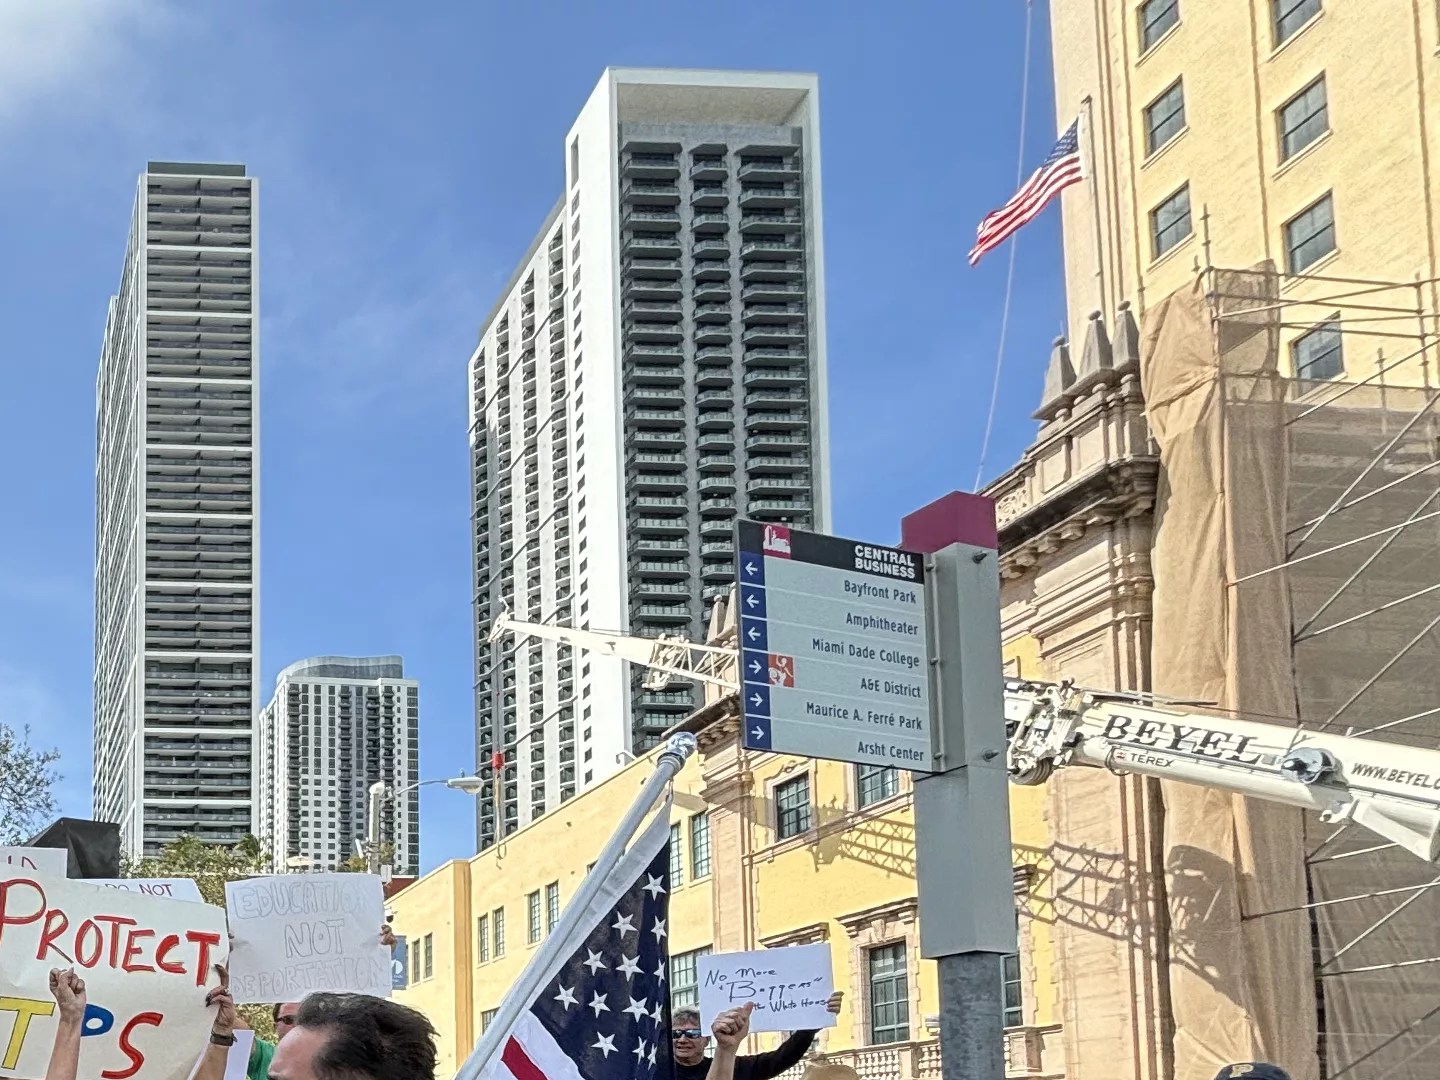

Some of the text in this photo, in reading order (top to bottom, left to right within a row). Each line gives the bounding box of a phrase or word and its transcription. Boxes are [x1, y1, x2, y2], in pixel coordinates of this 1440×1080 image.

[854, 545, 915, 567] CENTRAL
[854, 557, 916, 579] BUSINESS
[844, 580, 916, 603] Bayfront Park
[846, 612, 918, 635] Amphitheater
[812, 638, 919, 669] Miami Dade College
[860, 678, 921, 698] A&E District
[806, 702, 922, 730] Maurice A. Ferré Park
[1102, 714, 1262, 765] BEYEL
[857, 741, 924, 761] Arsht Center
[1131, 753, 1176, 768] TEREX
[138, 883, 173, 897] NOT
[232, 880, 377, 920] EDUCATION
[284, 918, 345, 959] NOT
[230, 956, 389, 999] DEPORTATION
[705, 969, 728, 988] No
[1229, 1063, 1254, 1079] P
